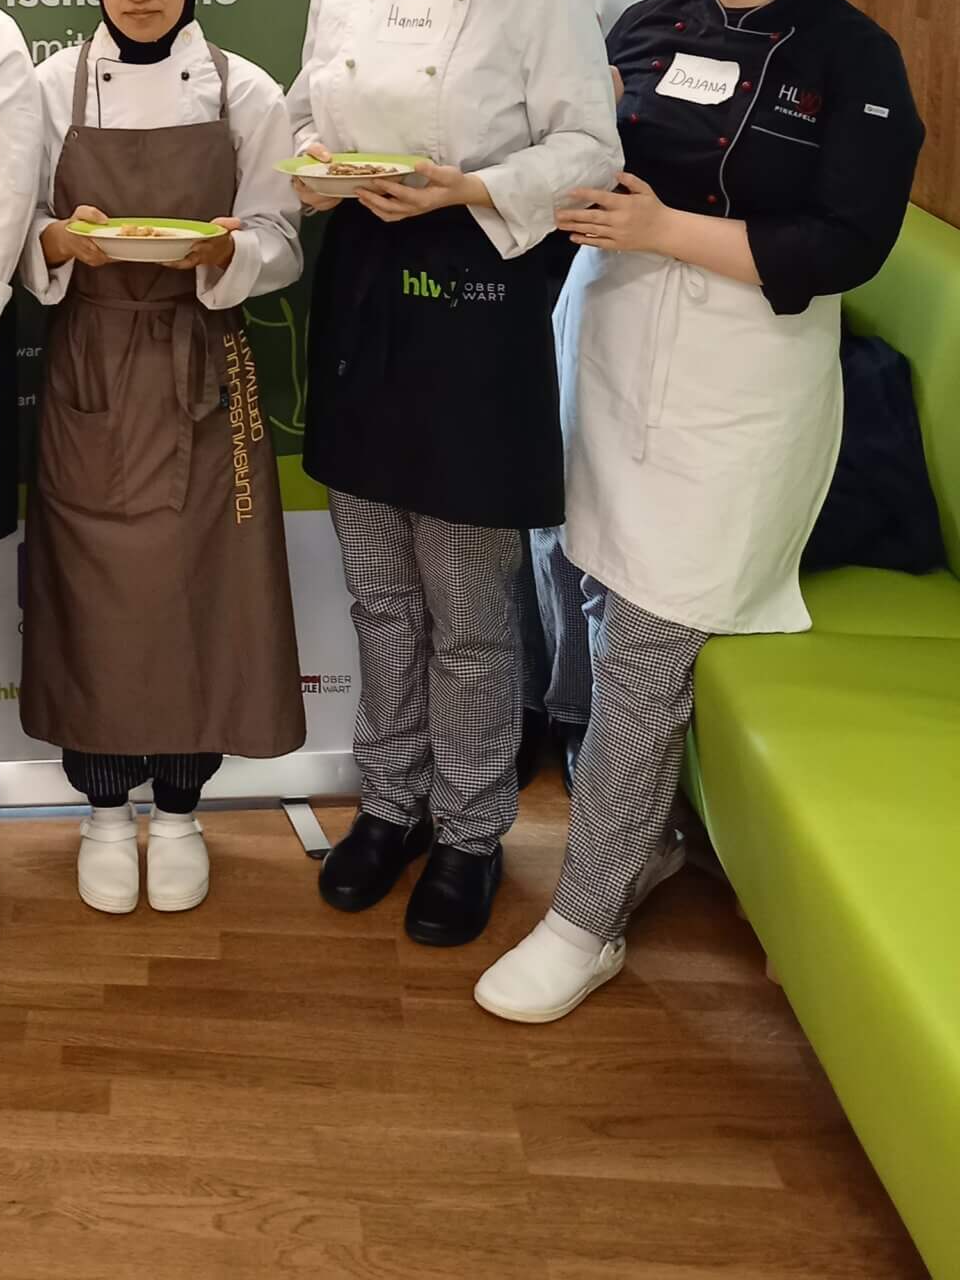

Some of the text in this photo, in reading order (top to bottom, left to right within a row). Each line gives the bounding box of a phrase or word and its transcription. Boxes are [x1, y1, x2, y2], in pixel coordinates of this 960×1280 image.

[387, 4, 432, 29] Hannah
[464, 282, 506, 292] OBER
[462, 292, 506, 301] WART
[223, 333, 255, 524] TOURISMUSSCHULE
[322, 674, 352, 684] OBER
